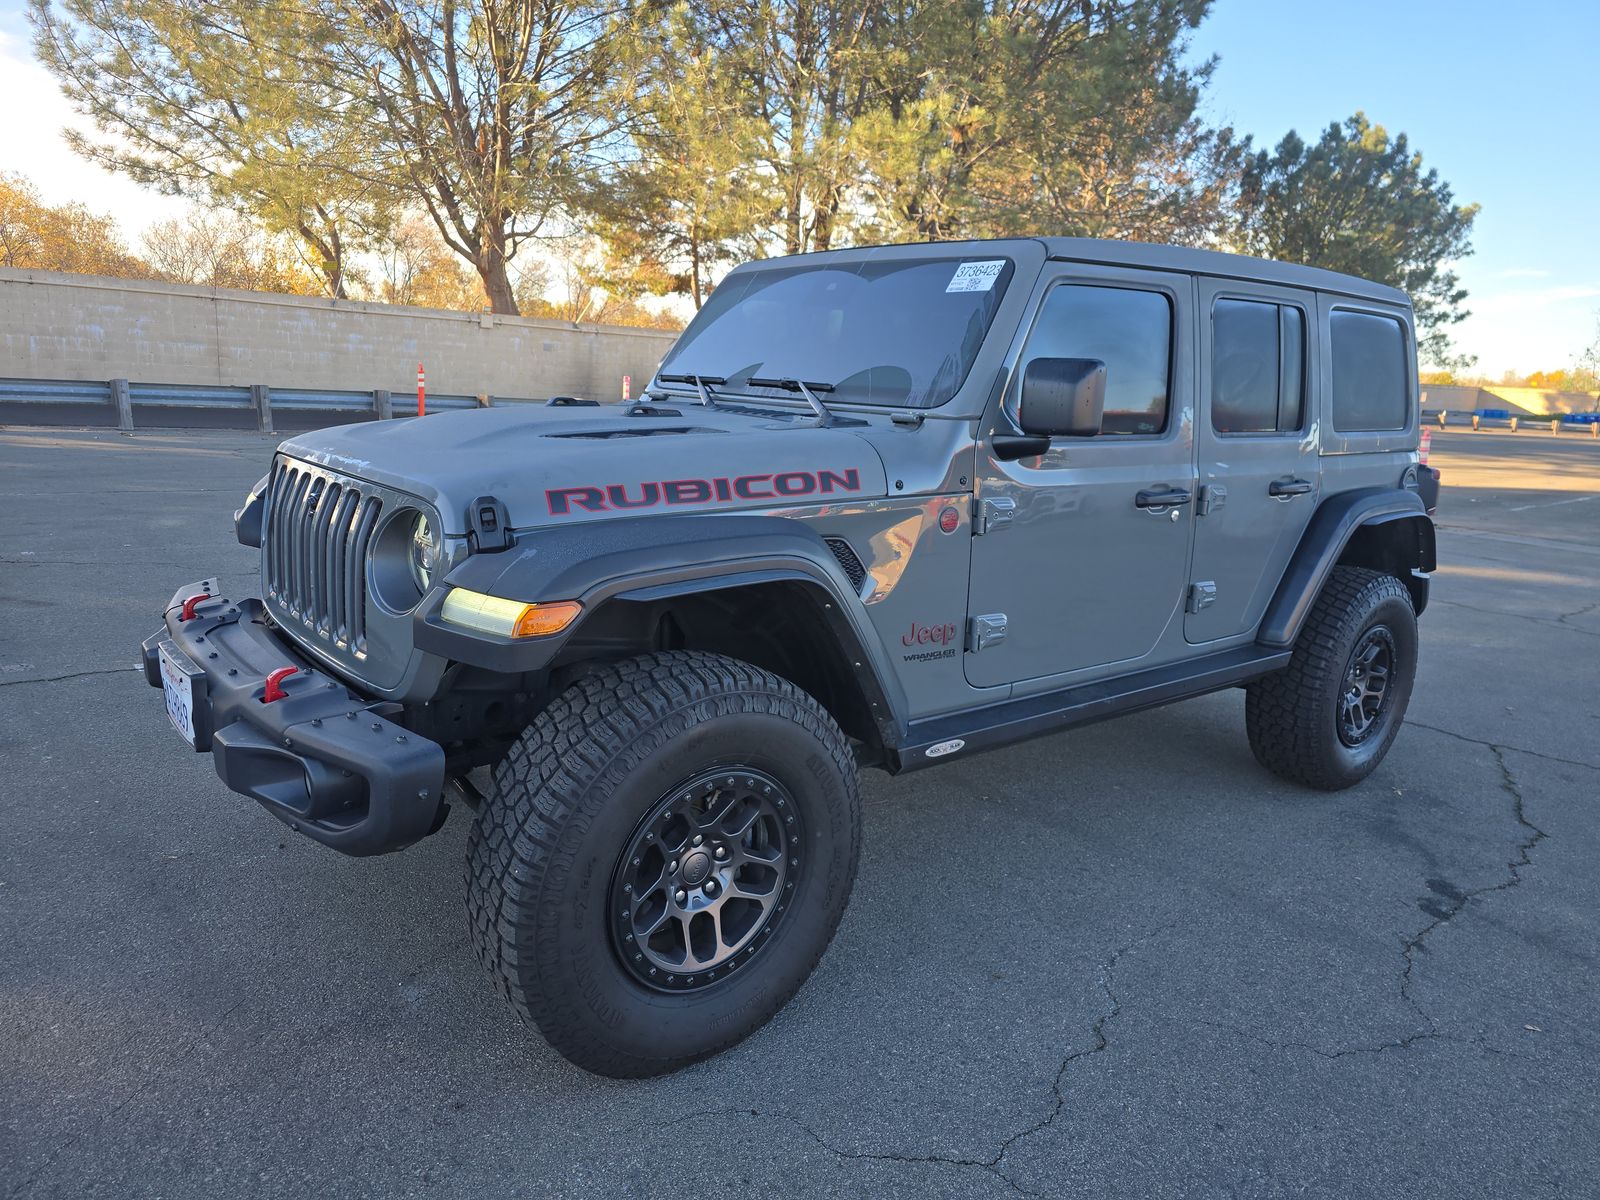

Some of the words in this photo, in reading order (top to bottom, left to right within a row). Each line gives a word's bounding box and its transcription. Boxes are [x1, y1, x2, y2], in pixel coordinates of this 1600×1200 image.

[957, 264, 1003, 278] 3736423
[545, 468, 861, 516] RUBICON
[902, 622, 956, 647] Jeep
[903, 648, 956, 662] WRANGLER
